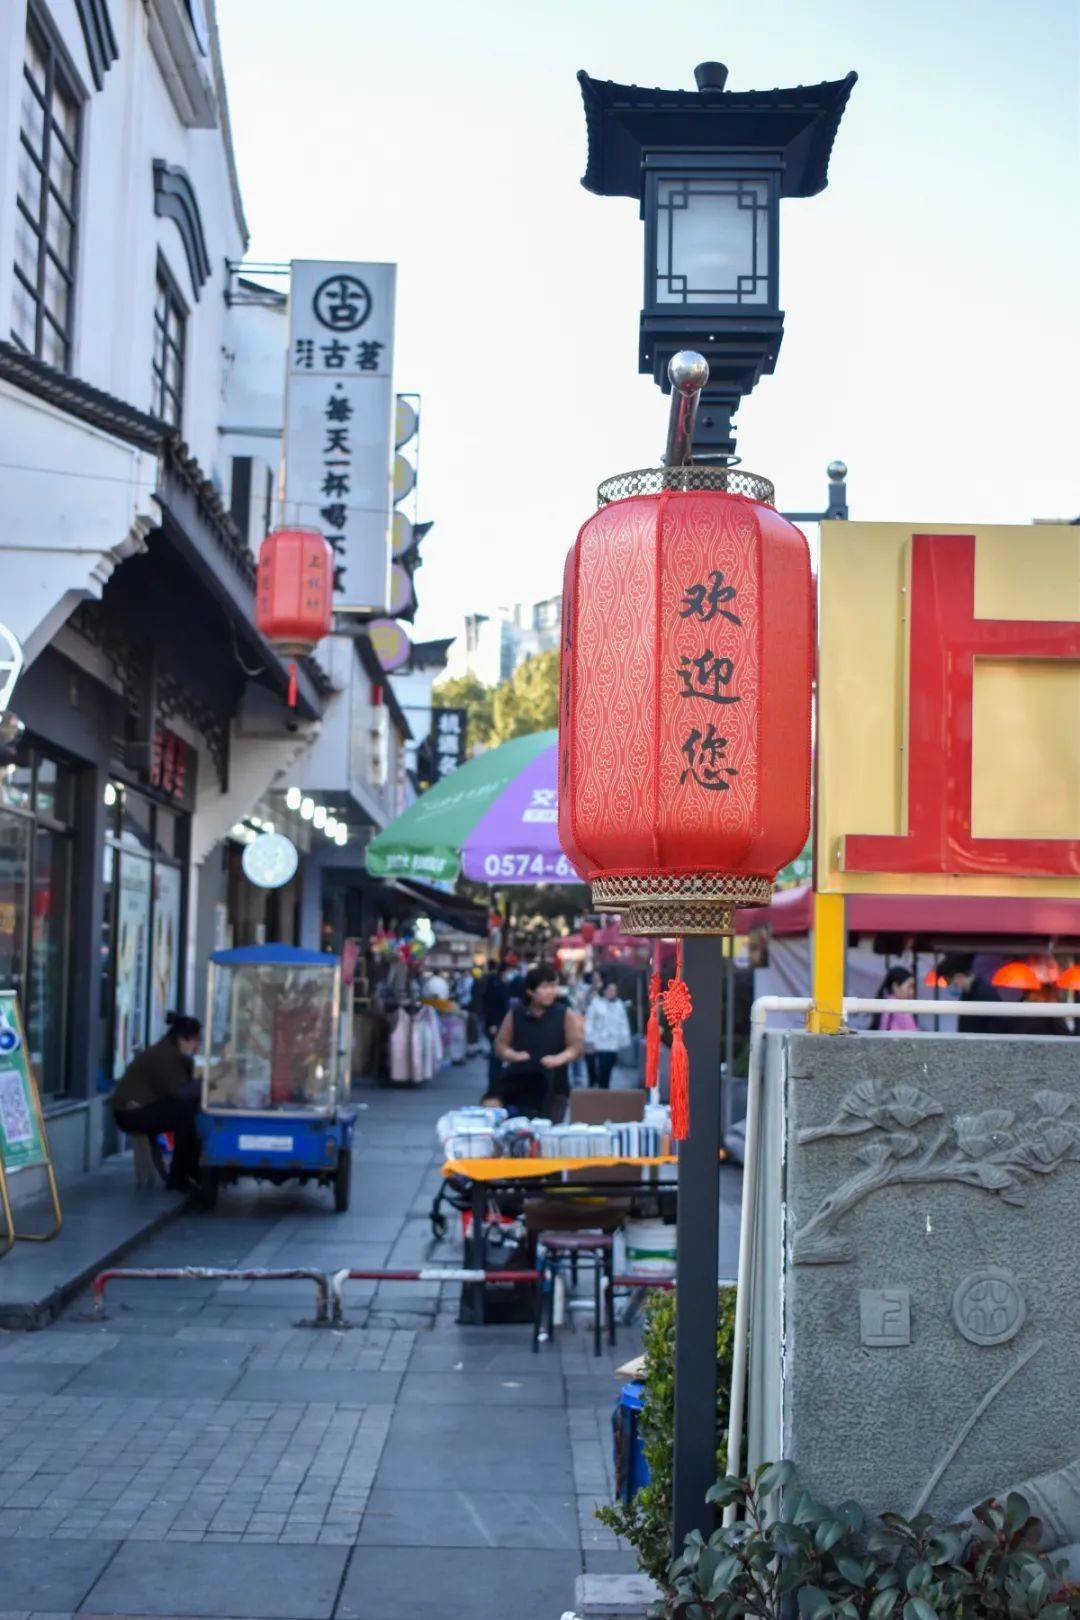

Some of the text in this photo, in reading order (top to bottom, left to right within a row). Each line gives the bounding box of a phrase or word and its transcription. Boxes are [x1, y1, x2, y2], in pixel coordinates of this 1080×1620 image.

[320, 338, 385, 371] 古茗
[676, 570, 742, 790] 欢迎您
